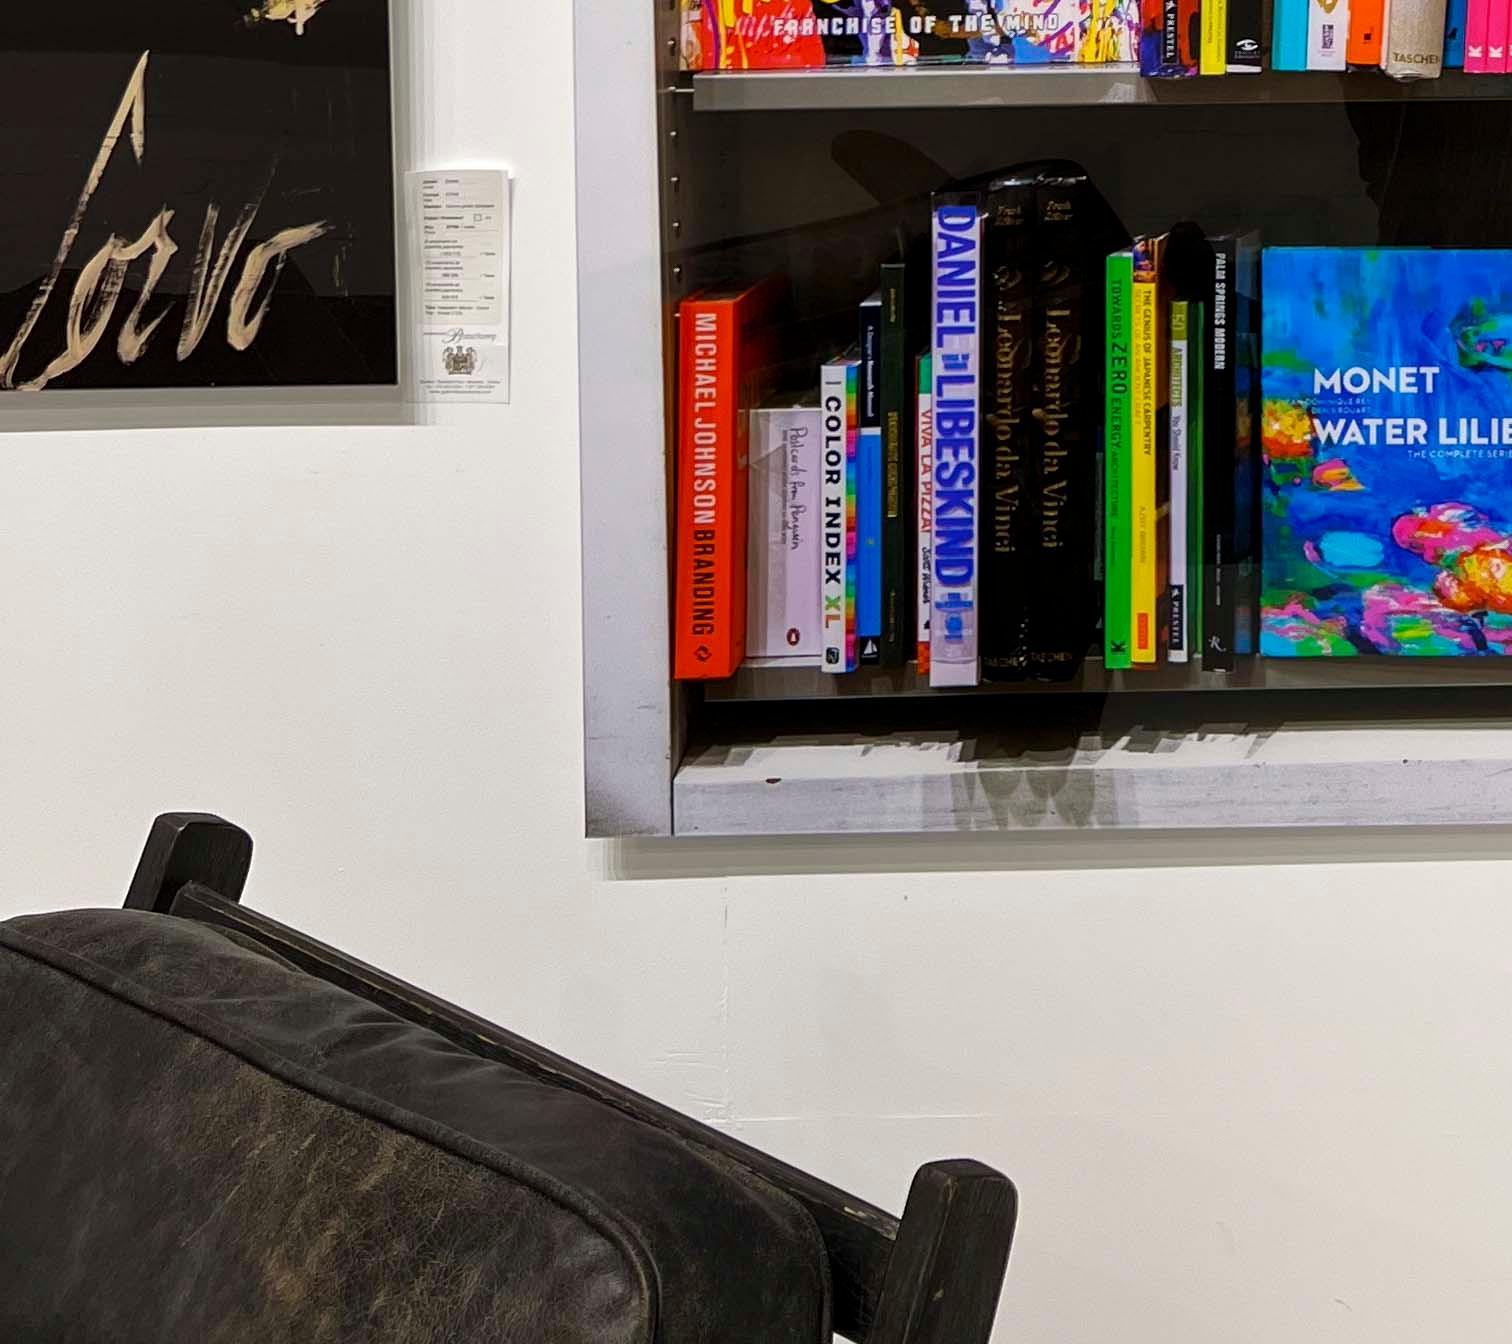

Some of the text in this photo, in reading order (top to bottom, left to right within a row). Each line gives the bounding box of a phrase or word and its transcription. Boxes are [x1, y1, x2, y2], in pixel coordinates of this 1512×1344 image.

[691, 313, 716, 636] MICHAEL JOHNSON BRANDING
[934, 205, 976, 586] DANIEL LIBESKIND
[1313, 418, 1428, 445] WATER
[1314, 366, 1440, 394] MONET
[824, 396, 841, 629] COLOR INDEX XL
